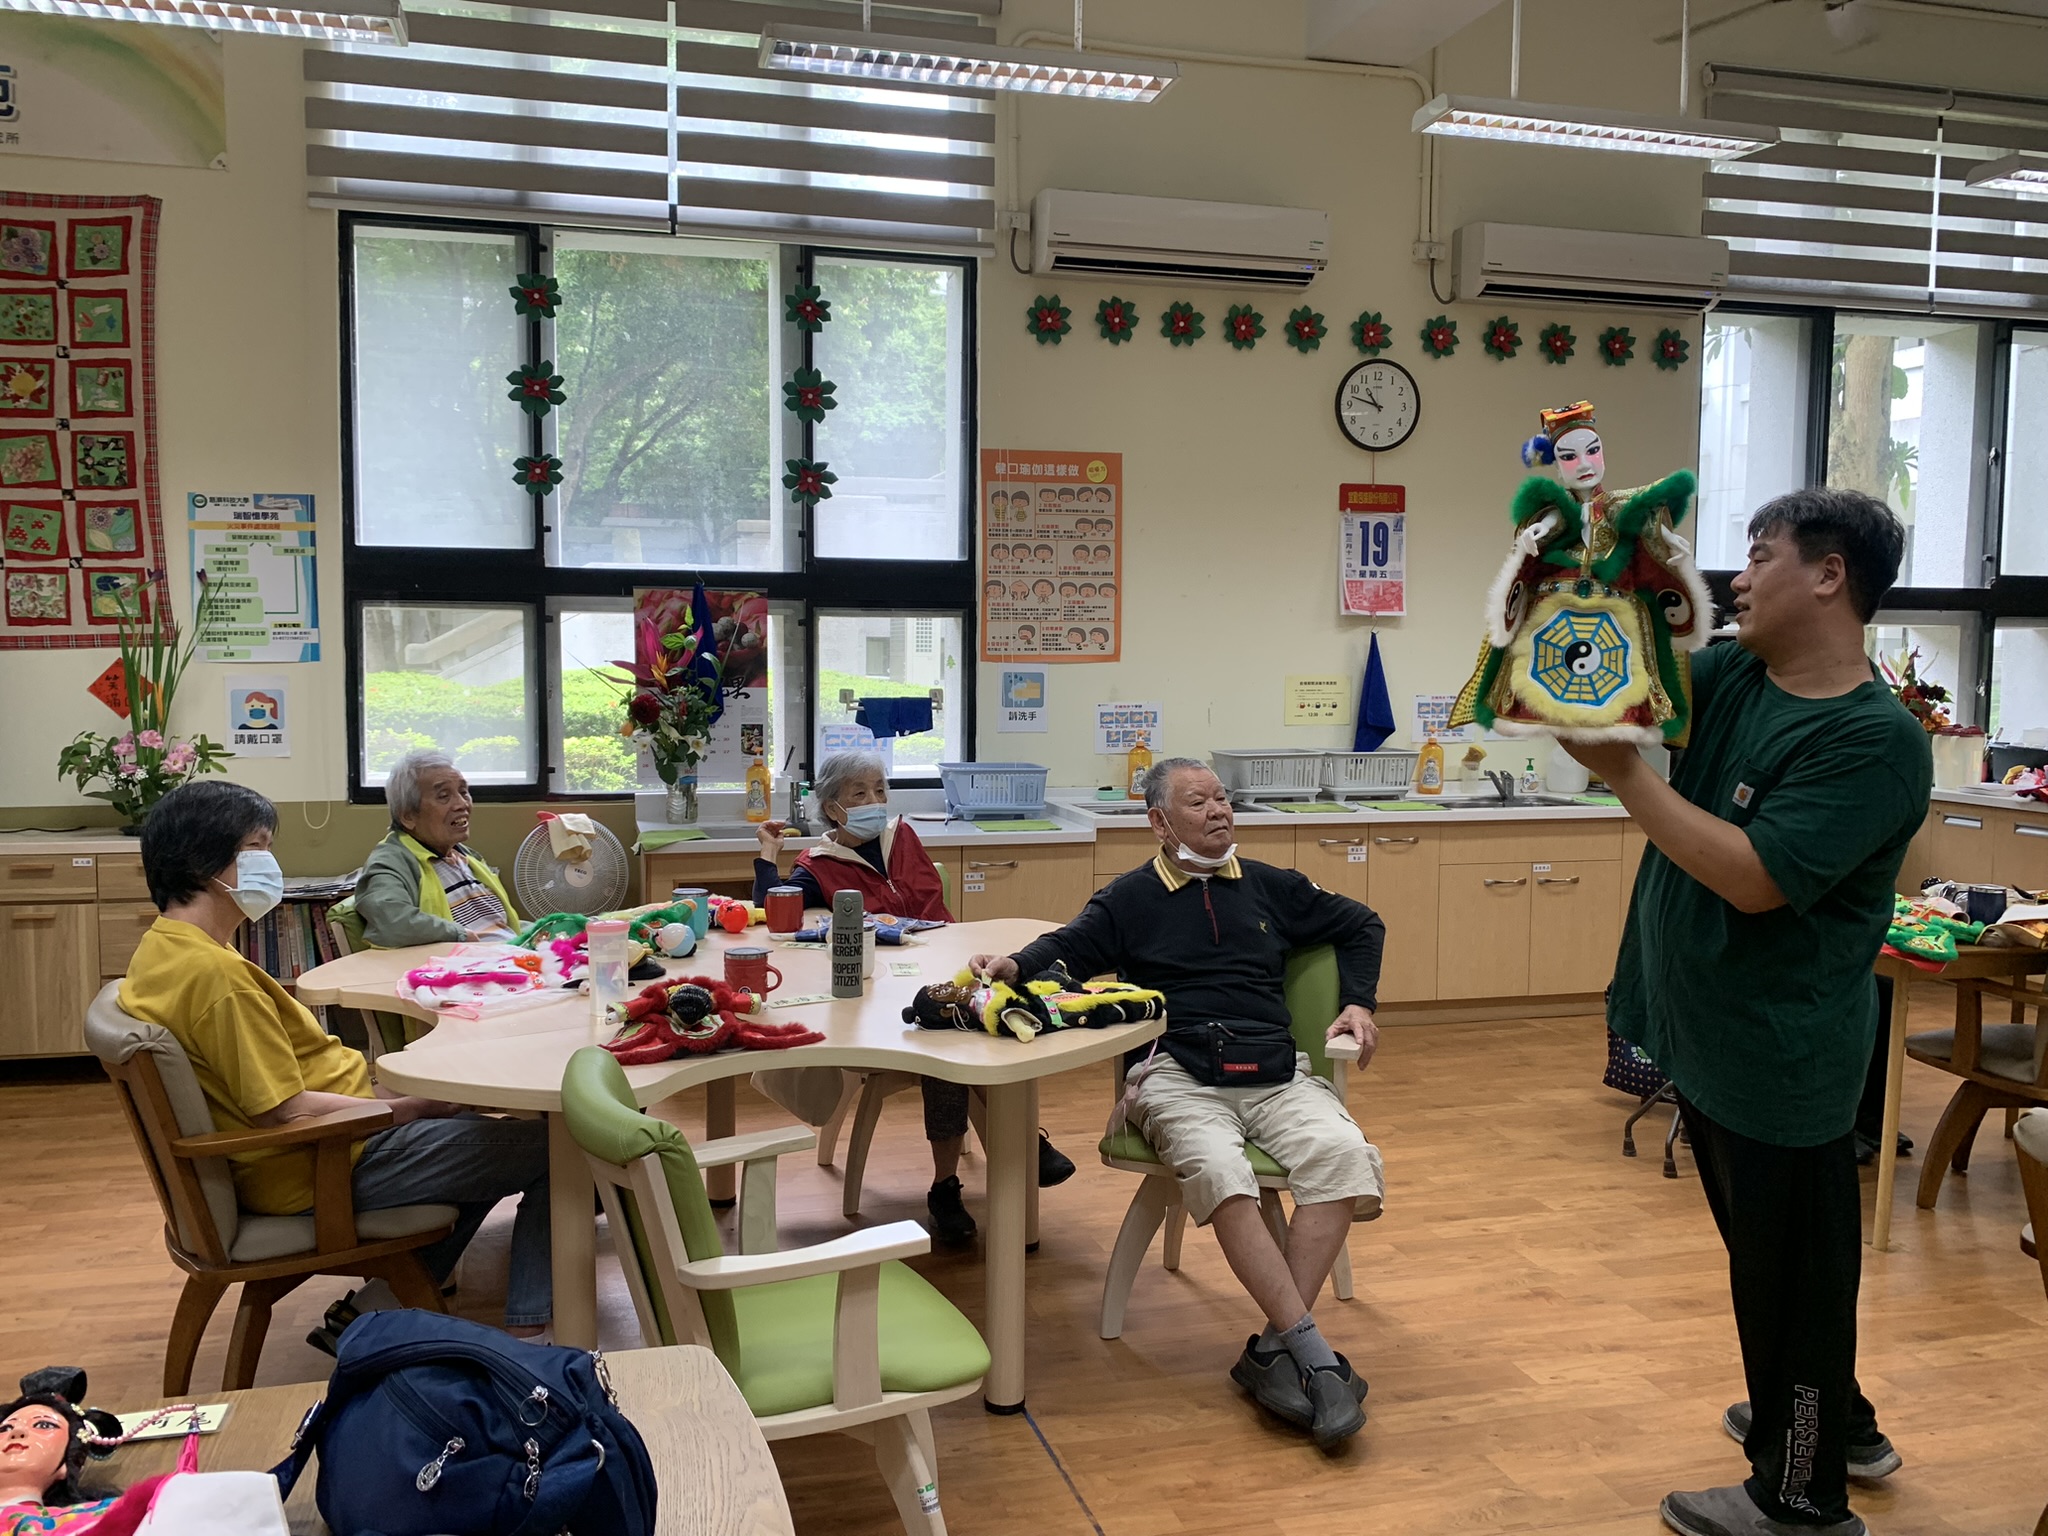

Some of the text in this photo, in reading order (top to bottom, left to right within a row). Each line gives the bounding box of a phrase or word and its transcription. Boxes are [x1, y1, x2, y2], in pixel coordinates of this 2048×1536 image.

[1360, 374, 1368, 384] 11
[1373, 371, 1383, 381] 12
[1390, 375, 1394, 385] 1
[1350, 384, 1360, 394] 10
[1398, 386, 1404, 396] 2
[1346, 400, 1353, 409] 9
[1400, 402, 1407, 412] 3
[1350, 415, 1356, 425] 8
[1396, 417, 1402, 427] 4
[1360, 426, 1366, 436] 7
[1372, 431, 1379, 441] 6
[1387, 427, 1393, 437] 5
[1359, 521, 1389, 567] 19
[1358, 570, 1388, 578] 星期五
[1008, 710, 1037, 721] 請洗手
[234, 733, 283, 744] 請戴口罩
